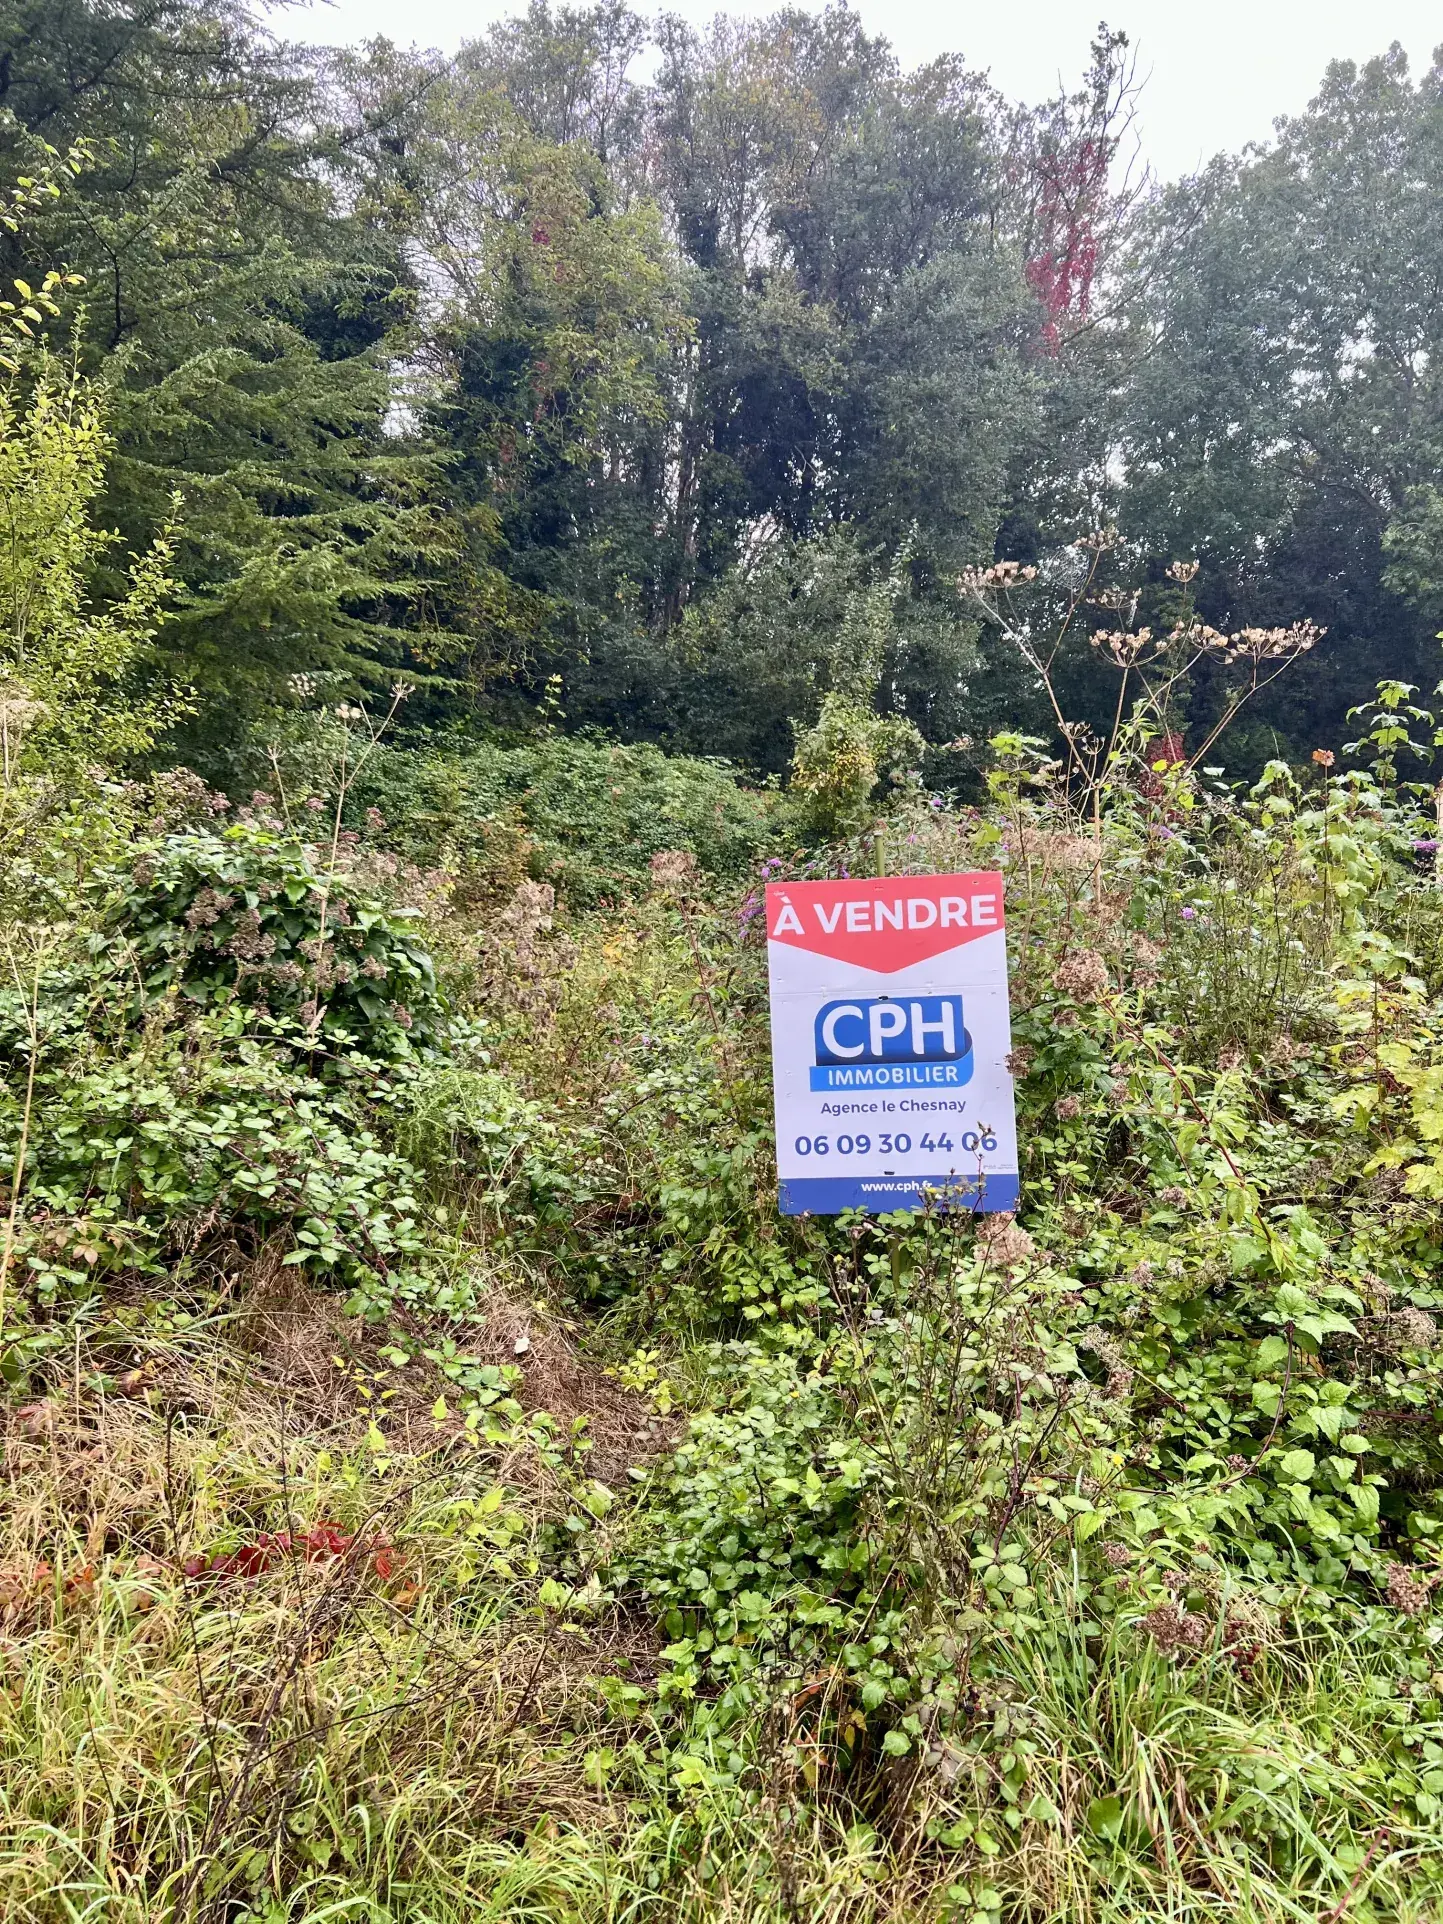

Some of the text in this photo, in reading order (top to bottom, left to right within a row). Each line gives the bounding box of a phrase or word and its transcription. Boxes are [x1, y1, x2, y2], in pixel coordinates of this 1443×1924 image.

[773, 894, 998, 936] À VENDRE
[822, 1001, 956, 1058] CPH
[828, 1066, 959, 1086] IMMOBILIER
[820, 1099, 966, 1116] Agence le Chesnay
[795, 1131, 998, 1155] 06 09 30 44 06
[861, 1180, 933, 1194] www.cph.fr
